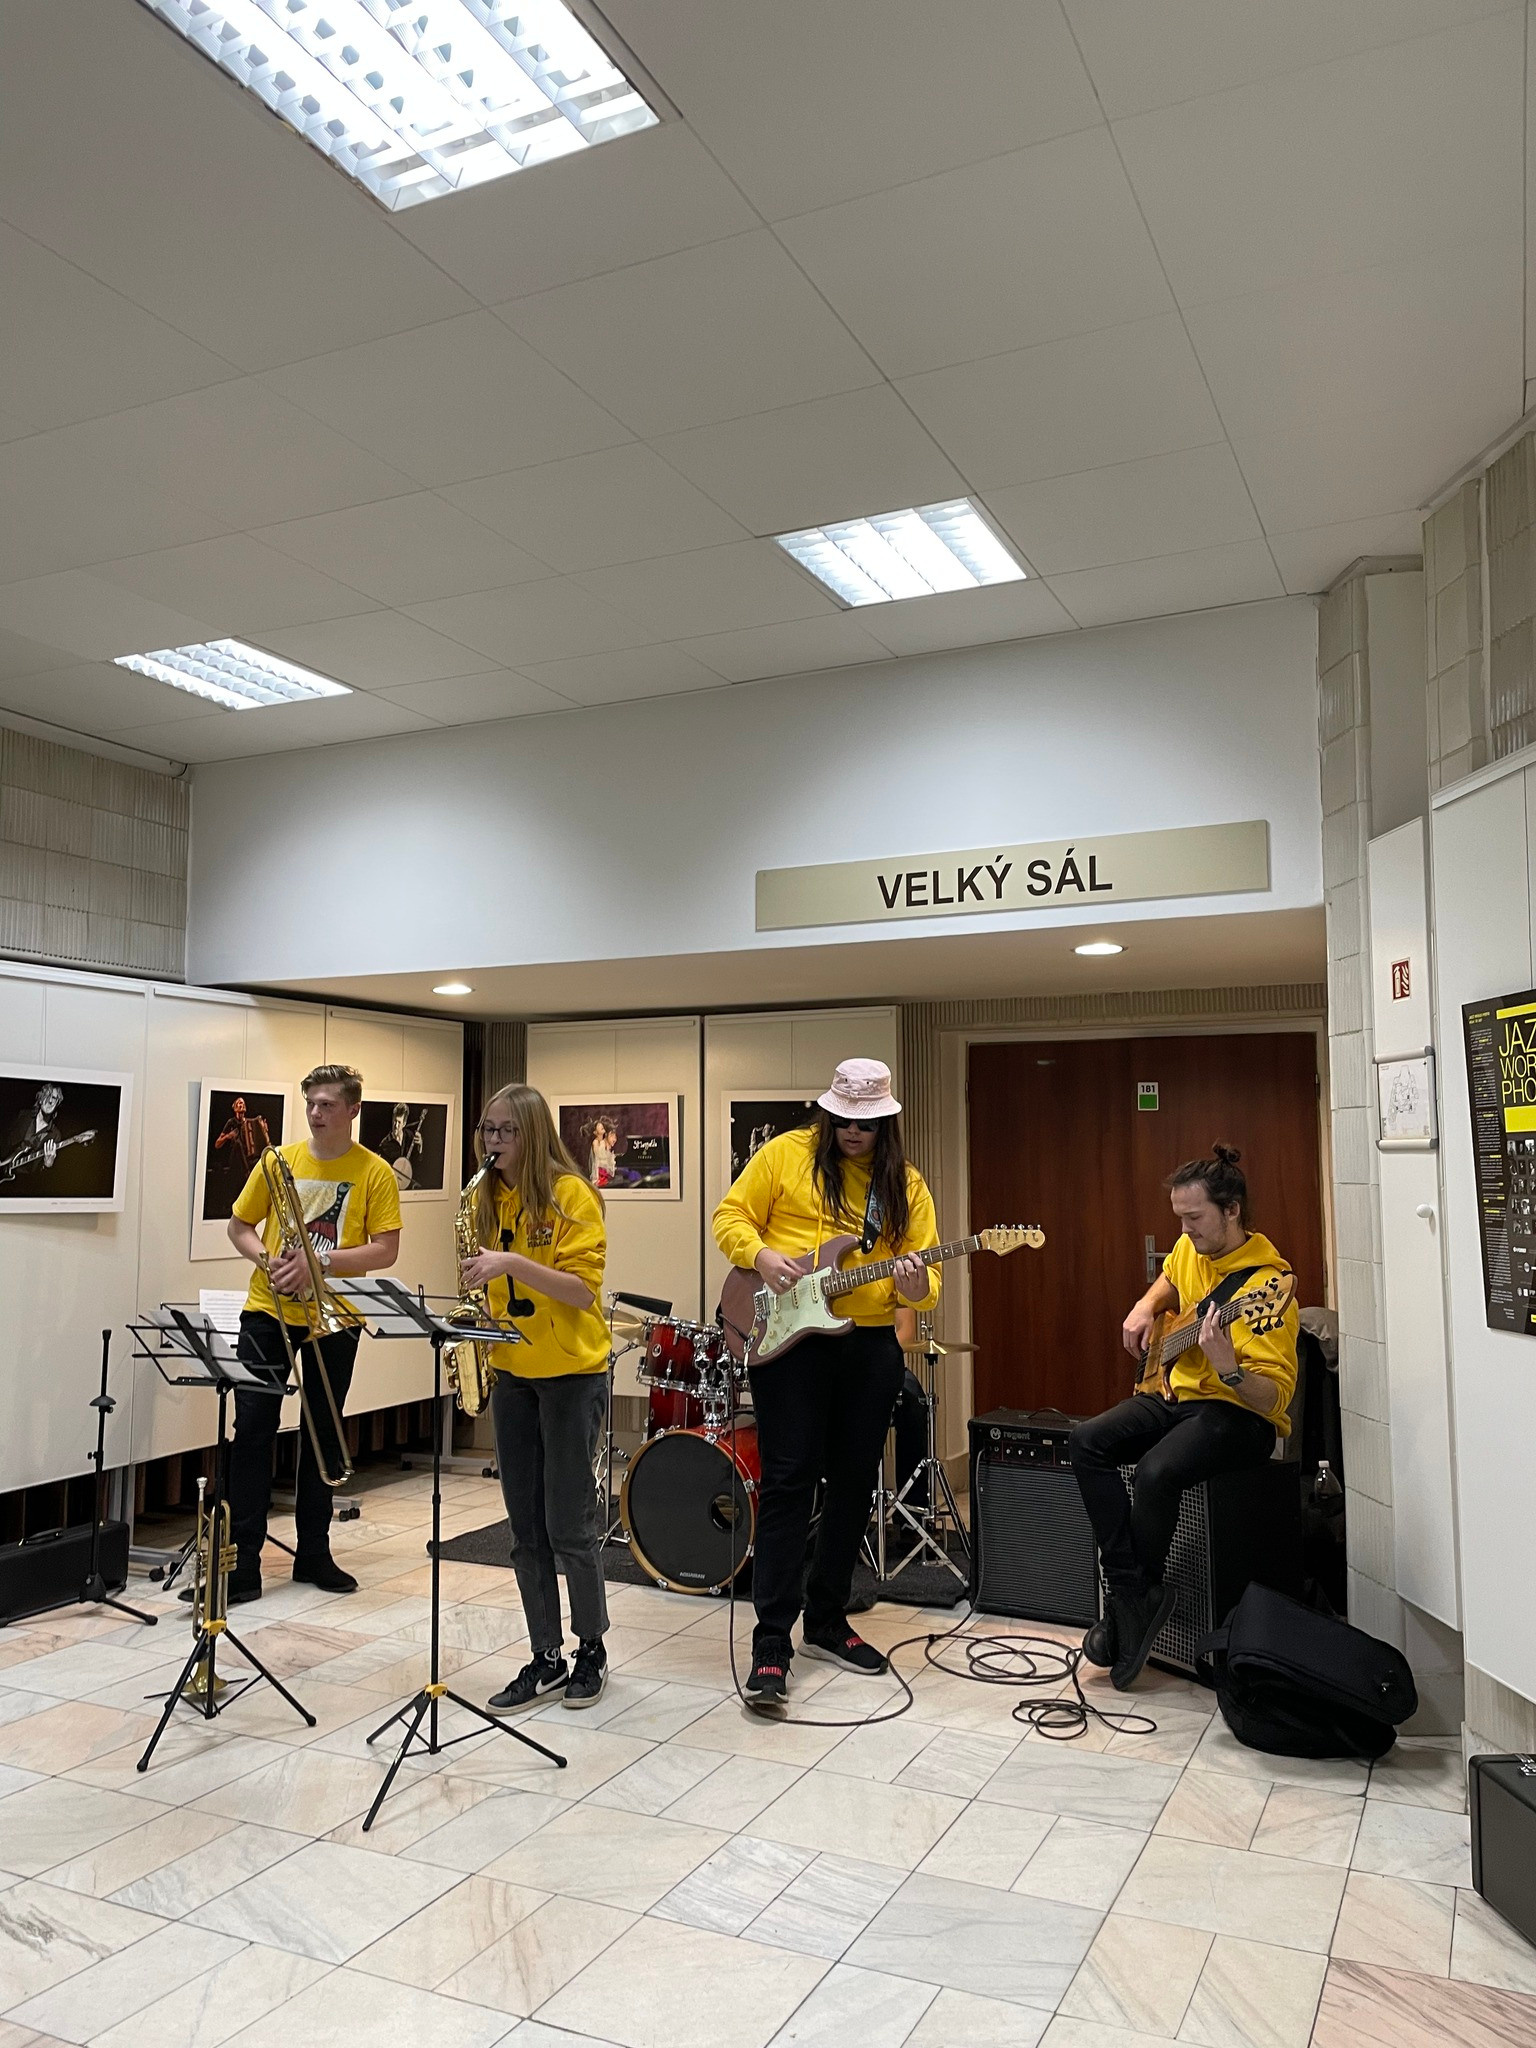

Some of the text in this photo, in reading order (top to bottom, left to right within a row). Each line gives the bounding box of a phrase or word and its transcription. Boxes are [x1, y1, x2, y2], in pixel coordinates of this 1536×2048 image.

[877, 848, 1113, 909] VELKÝ SÁL
[1141, 1085, 1155, 1093] 181
[1003, 1431, 1031, 1440] regent
